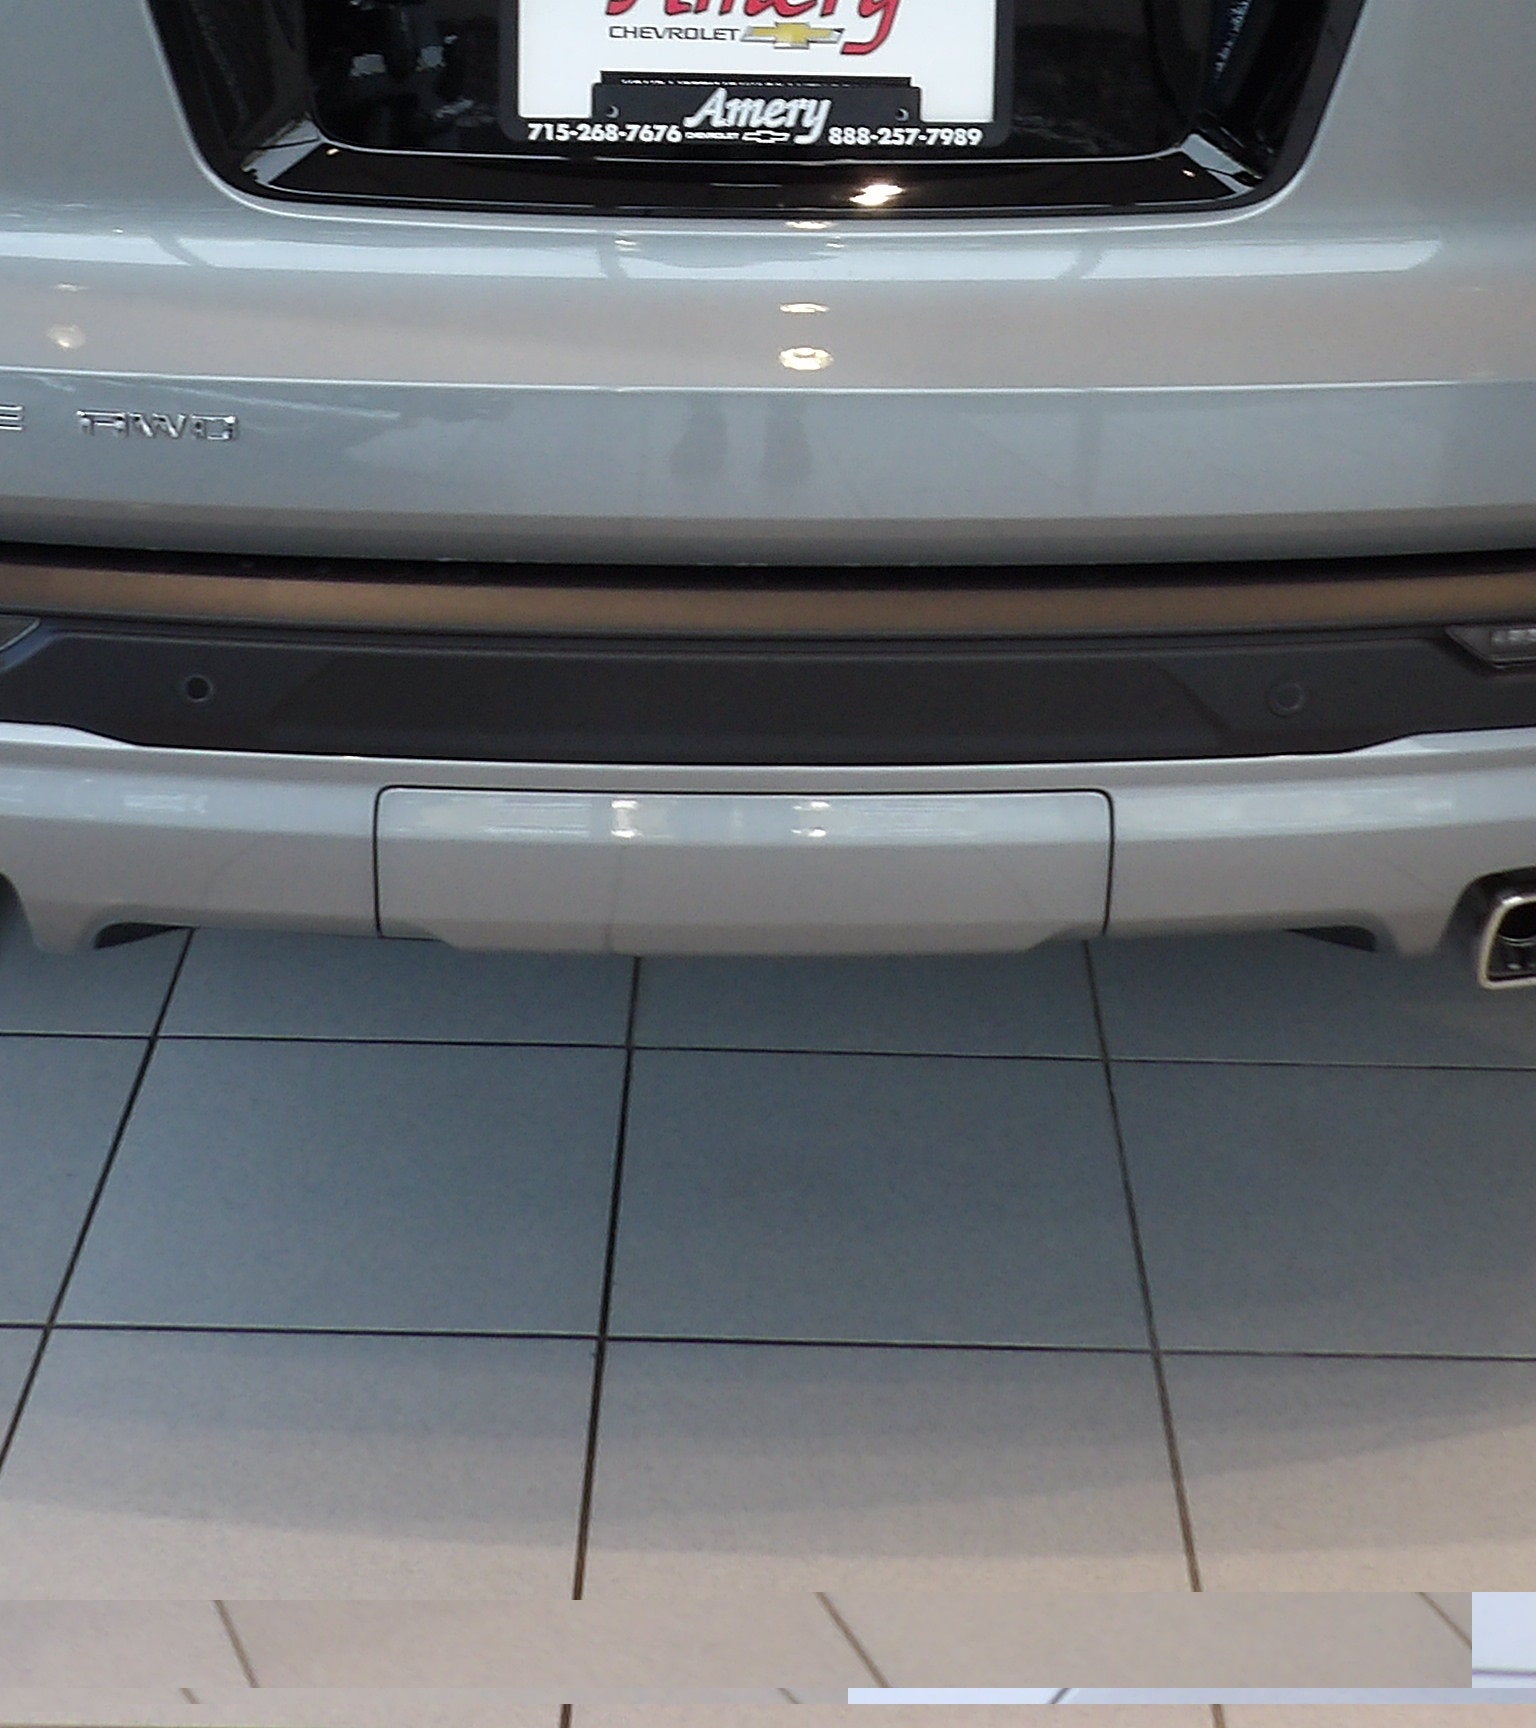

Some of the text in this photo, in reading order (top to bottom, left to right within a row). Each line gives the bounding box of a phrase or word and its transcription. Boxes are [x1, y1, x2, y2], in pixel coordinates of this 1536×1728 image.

[609, 25, 740, 41] CHEVROLET
[683, 87, 832, 145] Amery
[527, 122, 682, 144] 715-268-7676
[827, 126, 983, 148] 888-257-7989
[76, 408, 237, 442] AWD
